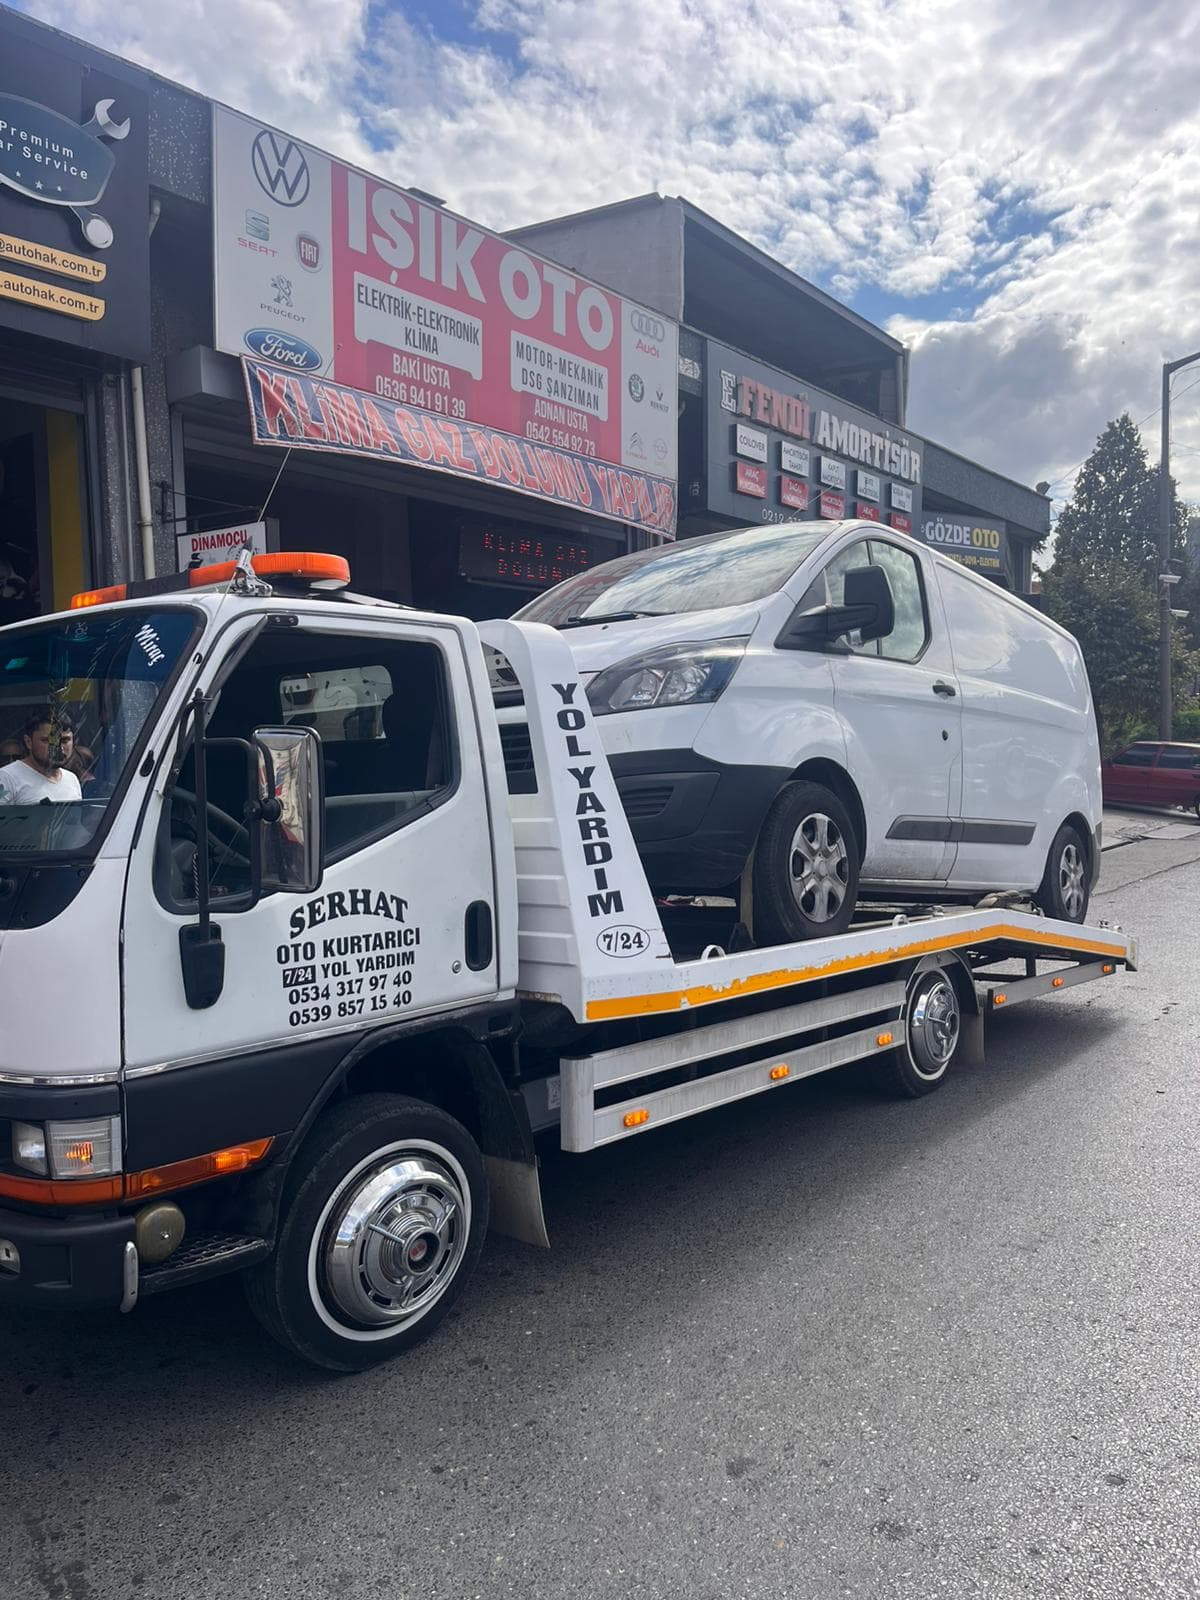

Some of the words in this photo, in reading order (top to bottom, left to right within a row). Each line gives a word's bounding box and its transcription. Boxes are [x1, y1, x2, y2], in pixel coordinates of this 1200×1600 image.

[0, 120, 73, 158] Premium
[22, 146, 88, 180] Service
[237, 237, 277, 257] SEAT
[301, 241, 317, 263] FIAT
[347, 171, 487, 304] IŞIK
[500, 249, 614, 351] OTO
[260, 303, 306, 323] PEUGEOT
[357, 283, 480, 346] ELEKTRİK-ELEKTRONİK
[260, 334, 308, 367] Ford
[404, 326, 439, 356] KLİMA
[393, 353, 421, 381] BAKİ
[423, 363, 451, 390] USTA
[516, 340, 604, 389] MOTOR-MEKANİK
[521, 367, 543, 391] DSG
[375, 374, 407, 403] 0536
[410, 385, 434, 409] 941
[435, 392, 448, 413] 91
[451, 397, 467, 419] 39
[534, 399, 565, 424] ADNAN
[567, 407, 588, 433] USTA
[526, 420, 551, 446] 0542
[551, 427, 569, 449] 554
[570, 434, 584, 454] 92
[584, 438, 596, 457] 73
[815, 410, 921, 484] AMORTİSÖR
[394, 407, 477, 472] GAZ
[467, 427, 593, 508] DOLUMU
[761, 508, 785, 524] 0212
[925, 517, 971, 545] GÖZDE
[972, 527, 1000, 549] OTO
[551, 683, 592, 757] YOL
[567, 765, 625, 918] YARDIM
[289, 888, 409, 939] SERHAT
[276, 941, 316, 965] OTO
[322, 928, 421, 959] KURTARICI
[602, 931, 644, 953] 7/24
[284, 967, 313, 985] 7/24
[321, 960, 351, 979] YOL
[356, 951, 415, 973] YARDIM
[288, 984, 331, 1005] 0534
[336, 978, 364, 997] 317
[369, 974, 388, 991] 97
[393, 970, 412, 987] 40
[289, 1005, 332, 1026] 0539
[337, 997, 365, 1018] 857
[370, 994, 387, 1012] 15
[393, 990, 412, 1008] 40
